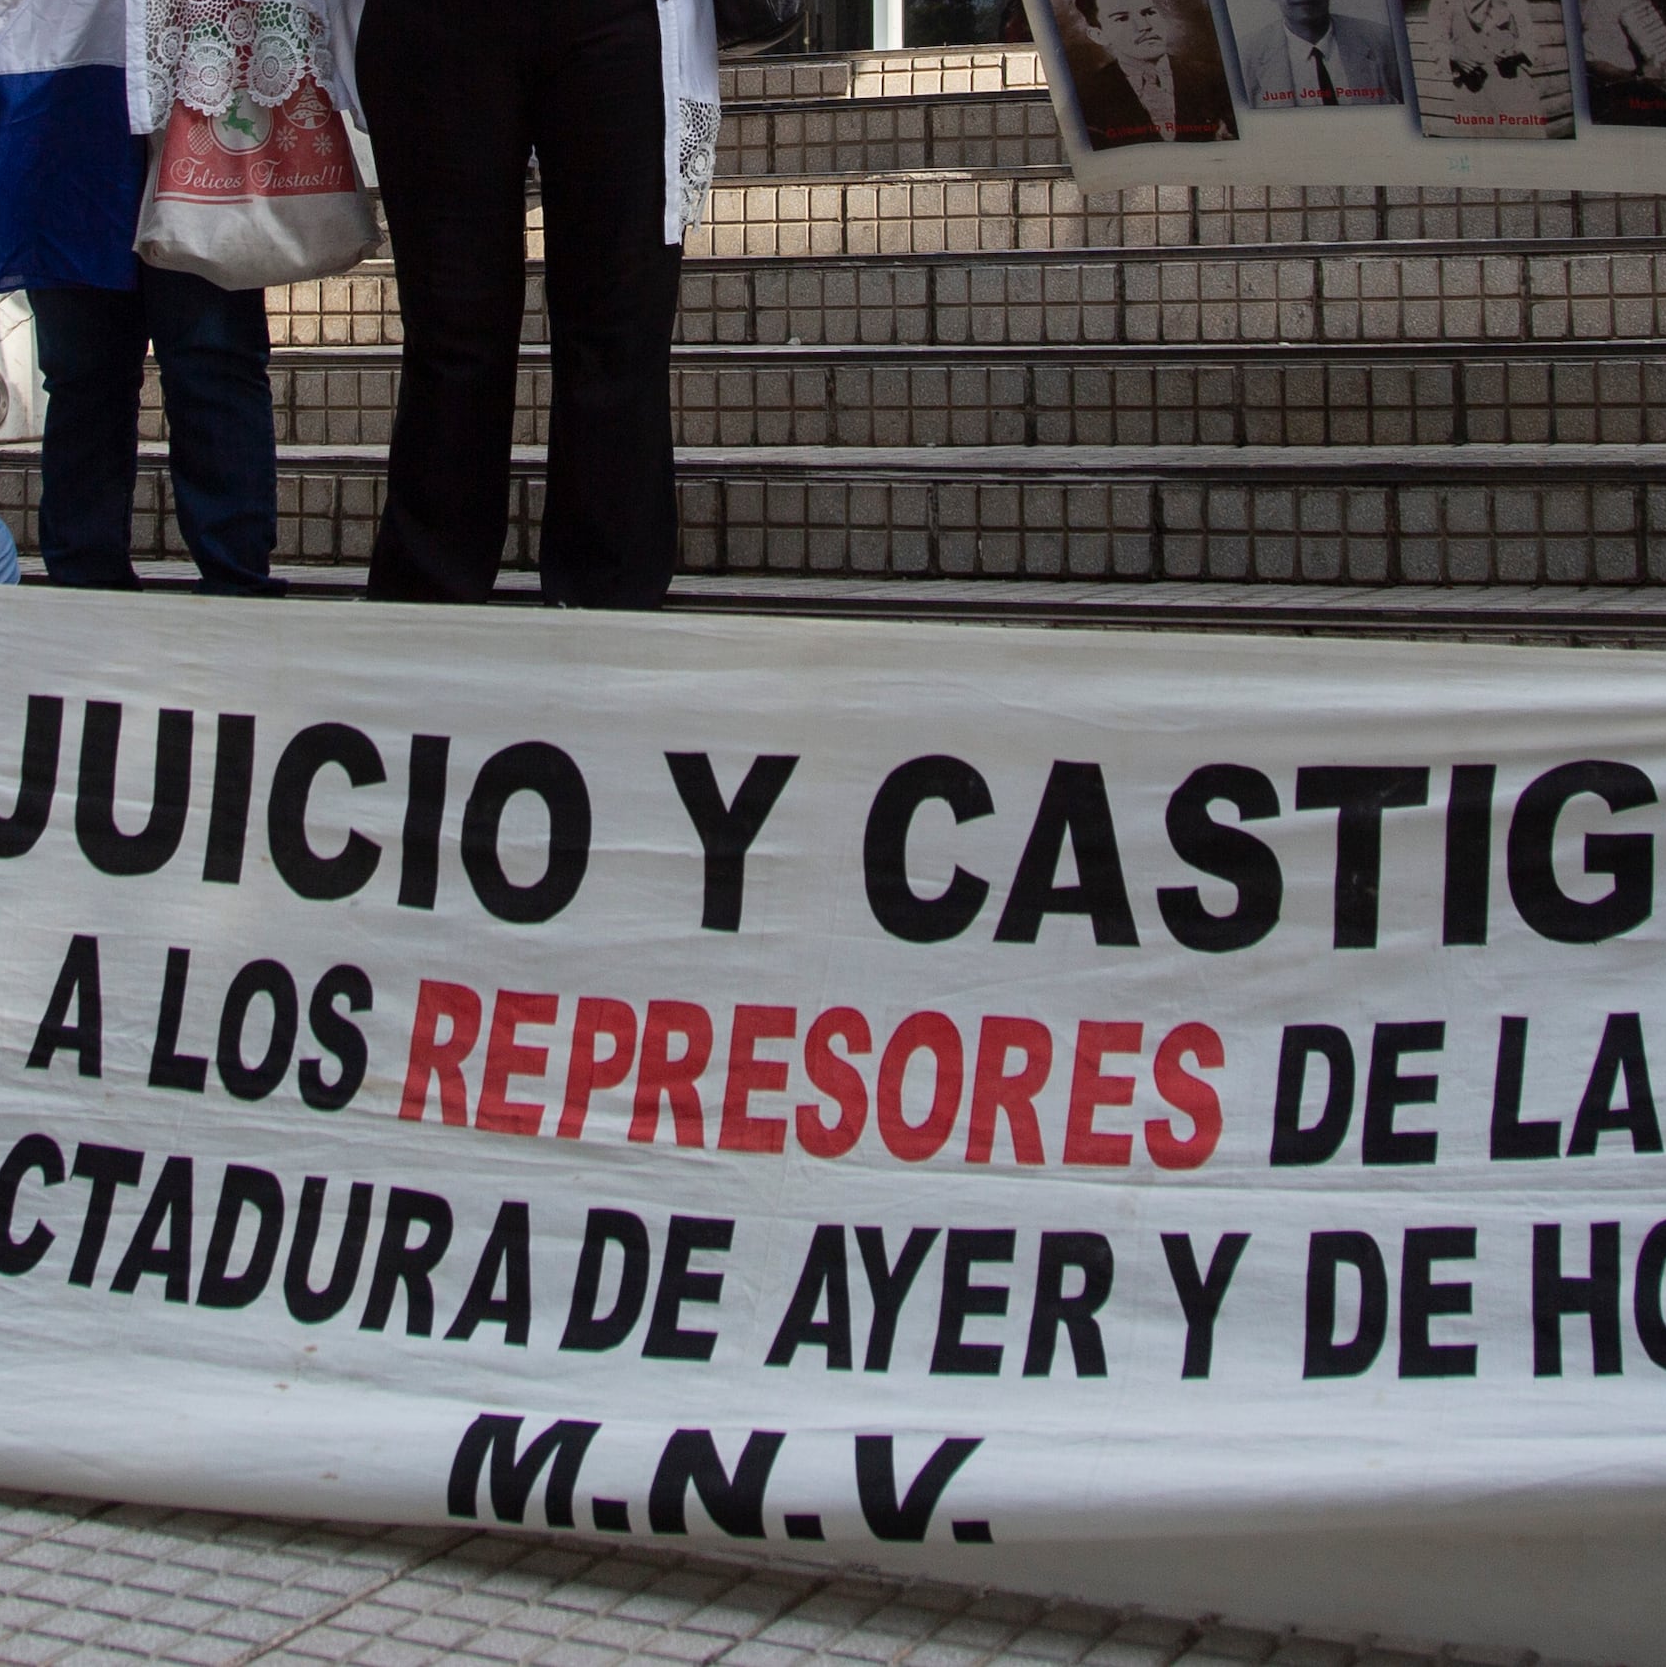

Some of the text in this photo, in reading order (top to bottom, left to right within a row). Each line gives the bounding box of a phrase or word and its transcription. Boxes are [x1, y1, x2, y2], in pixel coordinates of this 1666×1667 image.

[1262, 90, 1295, 102] Juan
[1454, 114, 1547, 126] Juana Peralta
[170, 156, 343, 190] Felices Fiestas!!!
[662, 751, 801, 933] Y
[25, 935, 1665, 1171] A LOS REPRESORES DE LA
[557, 1207, 736, 1362] DE
[763, 1223, 1115, 1378] AYER
[1159, 1232, 1251, 1380] Y
[1302, 1226, 1478, 1380] DE
[446, 1413, 994, 1544] M.N.V.
